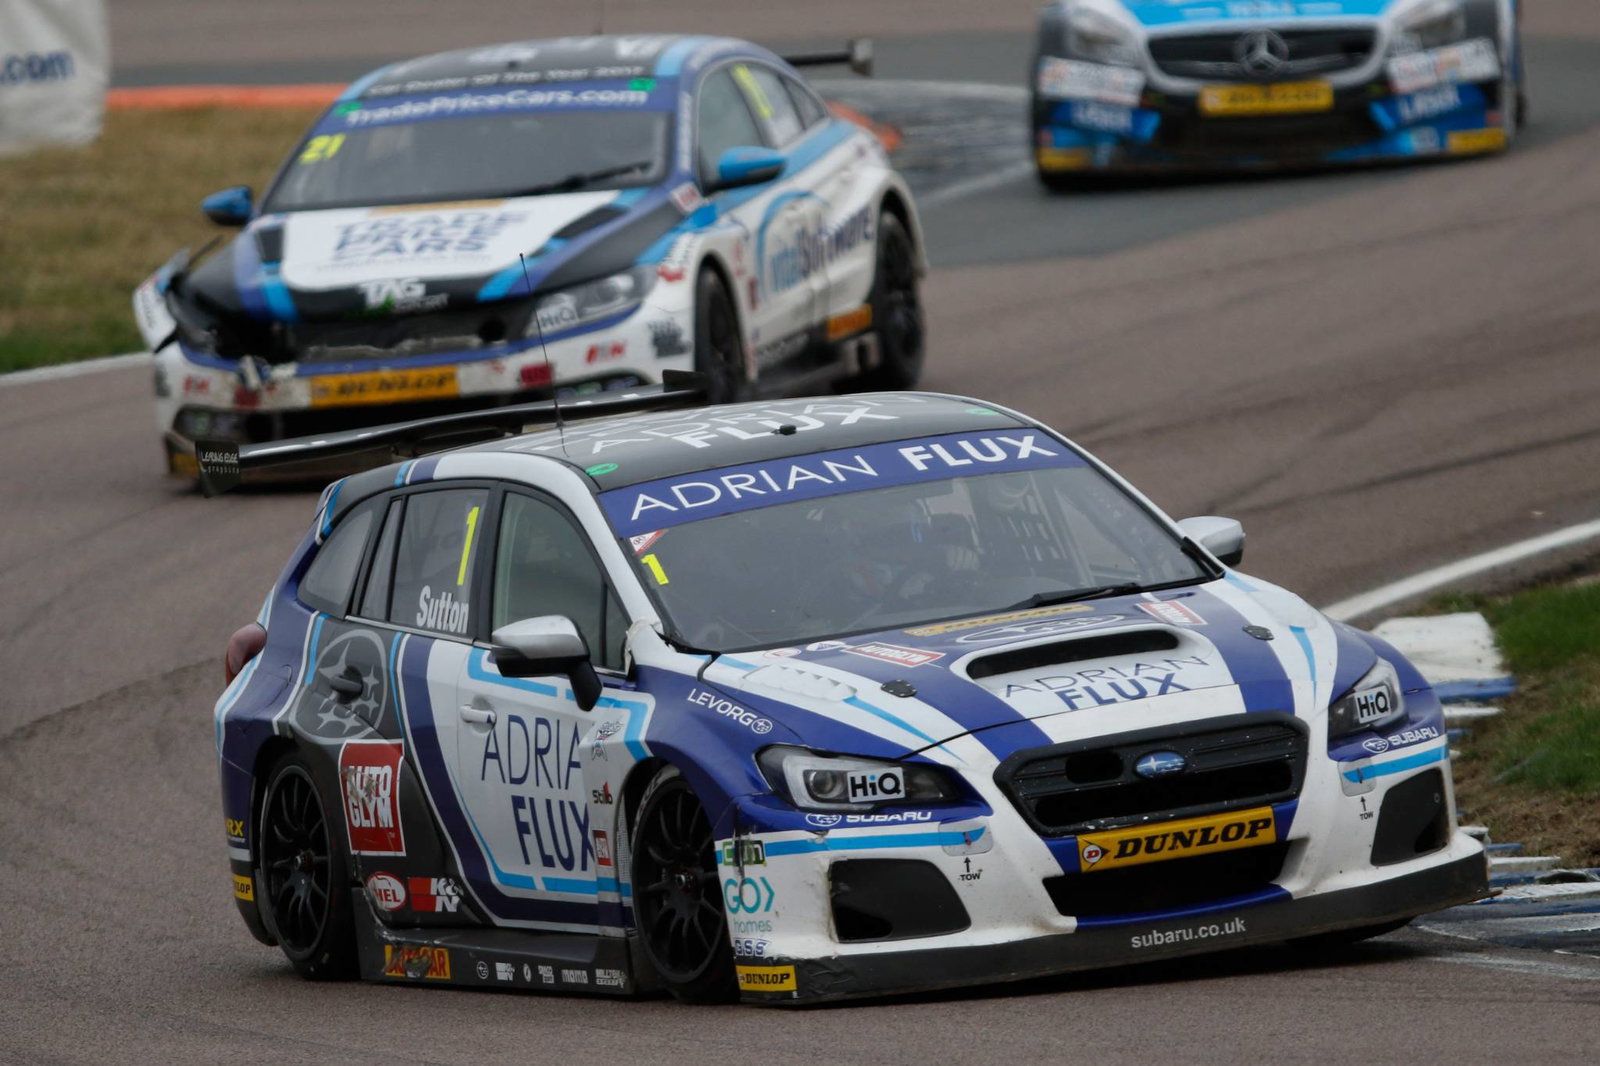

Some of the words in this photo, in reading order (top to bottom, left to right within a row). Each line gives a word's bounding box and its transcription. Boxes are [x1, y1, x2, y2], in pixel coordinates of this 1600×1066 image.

[346, 88, 649, 126] TradePriceCars.com
[300, 133, 346, 164] 21
[672, 406, 900, 449] FLUX
[631, 455, 879, 521] ADRIAN
[898, 434, 1059, 471] FLUX
[457, 506, 480, 586] 1
[641, 554, 670, 585] 1
[416, 585, 469, 634] Sutton
[1005, 655, 1210, 698] ADRIAN
[1055, 672, 1192, 711] FLUX
[687, 688, 758, 726] LEVORG
[1357, 691, 1389, 718] HiQ
[482, 714, 583, 790] ADRIA
[1388, 726, 1439, 746] SUBARU
[347, 765, 392, 799] AUTO
[850, 772, 902, 798] HiQ
[348, 796, 394, 829] GLYM
[846, 811, 932, 823] SUBARU
[1360, 811, 1374, 820] TOW
[511, 794, 596, 872] FLUX
[1113, 817, 1272, 859] DUNLOP
[235, 881, 251, 894] LOP
[960, 871, 981, 882] TOW
[733, 918, 773, 934] homes
[1131, 917, 1247, 949] subaru.co.uk
[561, 969, 589, 984] momo
[745, 973, 791, 985] DUNLOP
